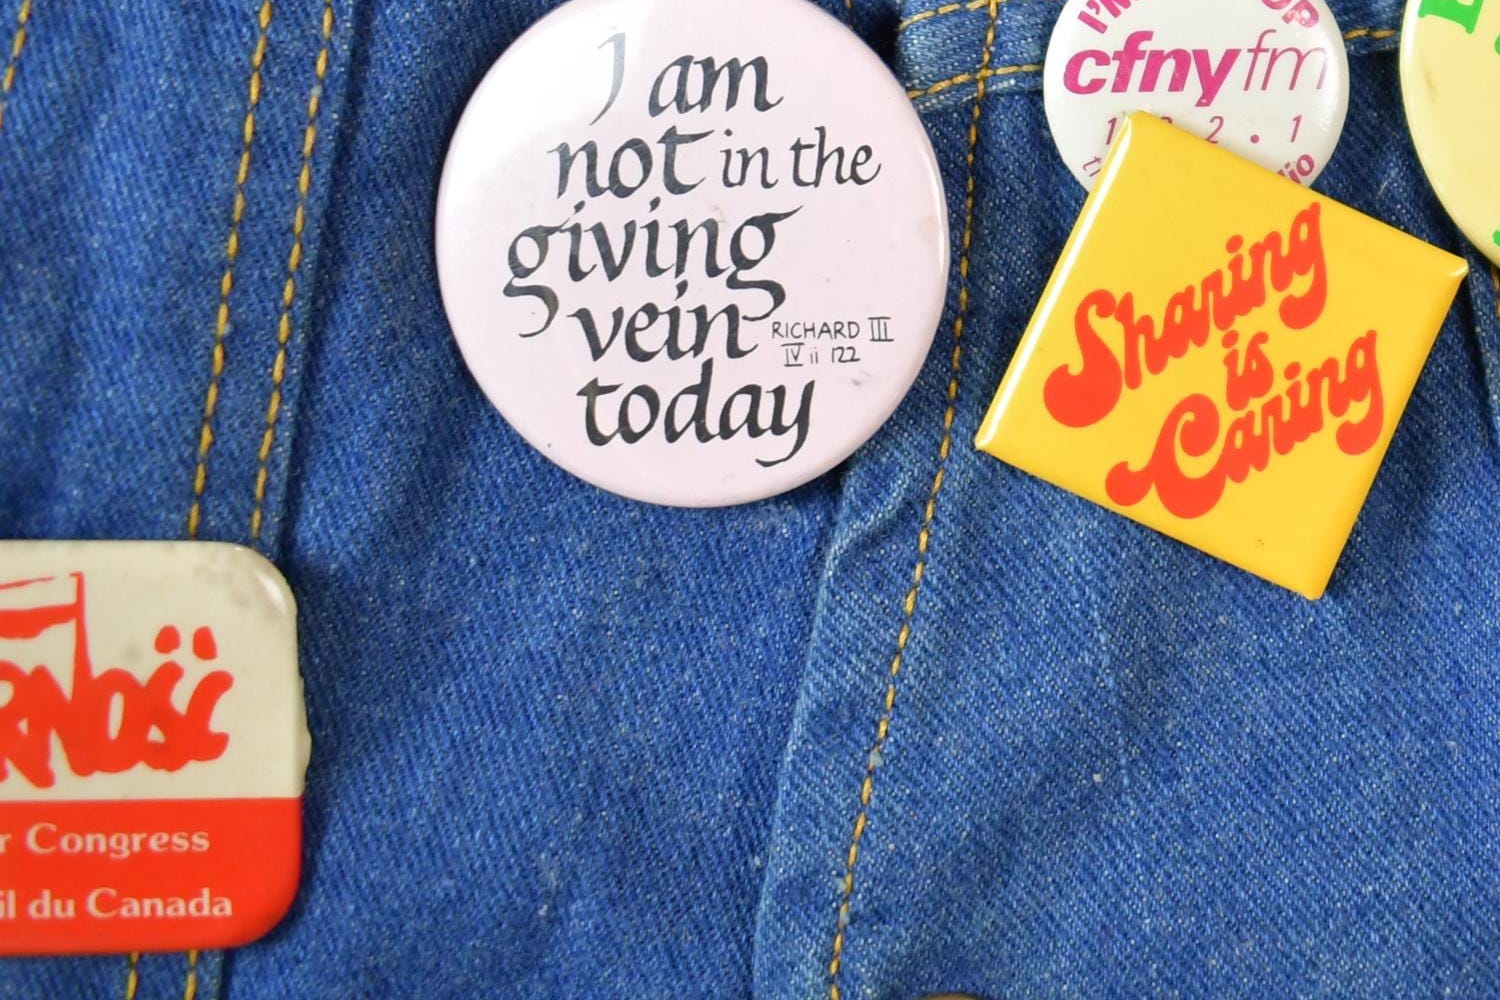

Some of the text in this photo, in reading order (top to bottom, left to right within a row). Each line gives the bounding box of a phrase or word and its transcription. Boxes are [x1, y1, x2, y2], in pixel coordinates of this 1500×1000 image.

[648, 54, 784, 118] am
[547, 125, 881, 199] not in the
[502, 197, 803, 338] giving
[566, 279, 758, 363] vein
[771, 316, 894, 342] RICHARD III
[1043, 201, 1328, 428] Sharing
[780, 342, 805, 367] IV
[1221, 329, 1275, 411] is
[576, 357, 816, 468] today
[1104, 329, 1385, 519] Caring
[25, 821, 211, 860] Congress
[27, 889, 76, 919] du
[86, 886, 233, 919] Canada
